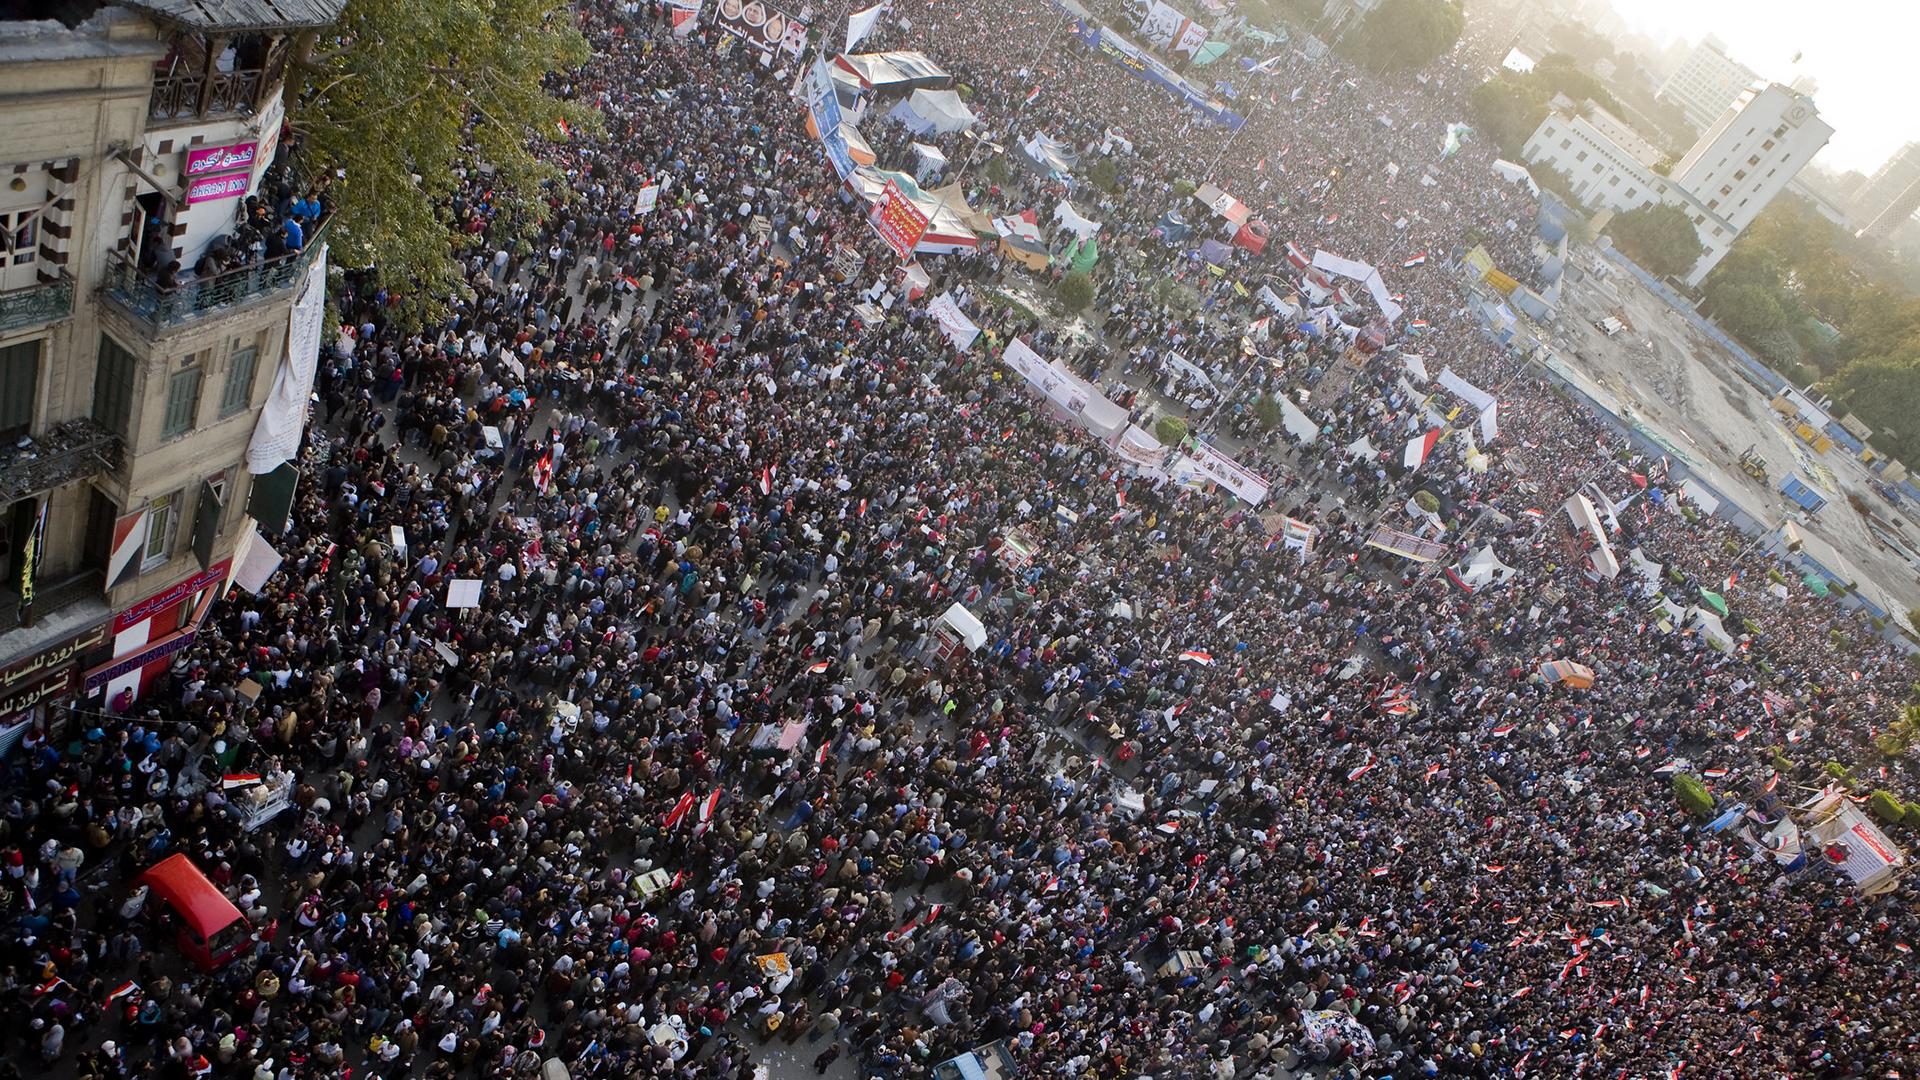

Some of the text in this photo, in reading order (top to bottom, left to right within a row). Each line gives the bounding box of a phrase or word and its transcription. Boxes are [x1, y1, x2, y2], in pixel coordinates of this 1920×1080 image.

[718, 19, 748, 39] الشعب
[189, 148, 224, 172] أكرم
[222, 146, 253, 167] فندق
[190, 178, 246, 198] AKRAM INN
[122, 582, 188, 625] للسياحة
[46, 628, 105, 668] بارون
[87, 662, 133, 690] SAFIR
[136, 635, 193, 667] TRAVEL
[16, 673, 70, 712] بارون
